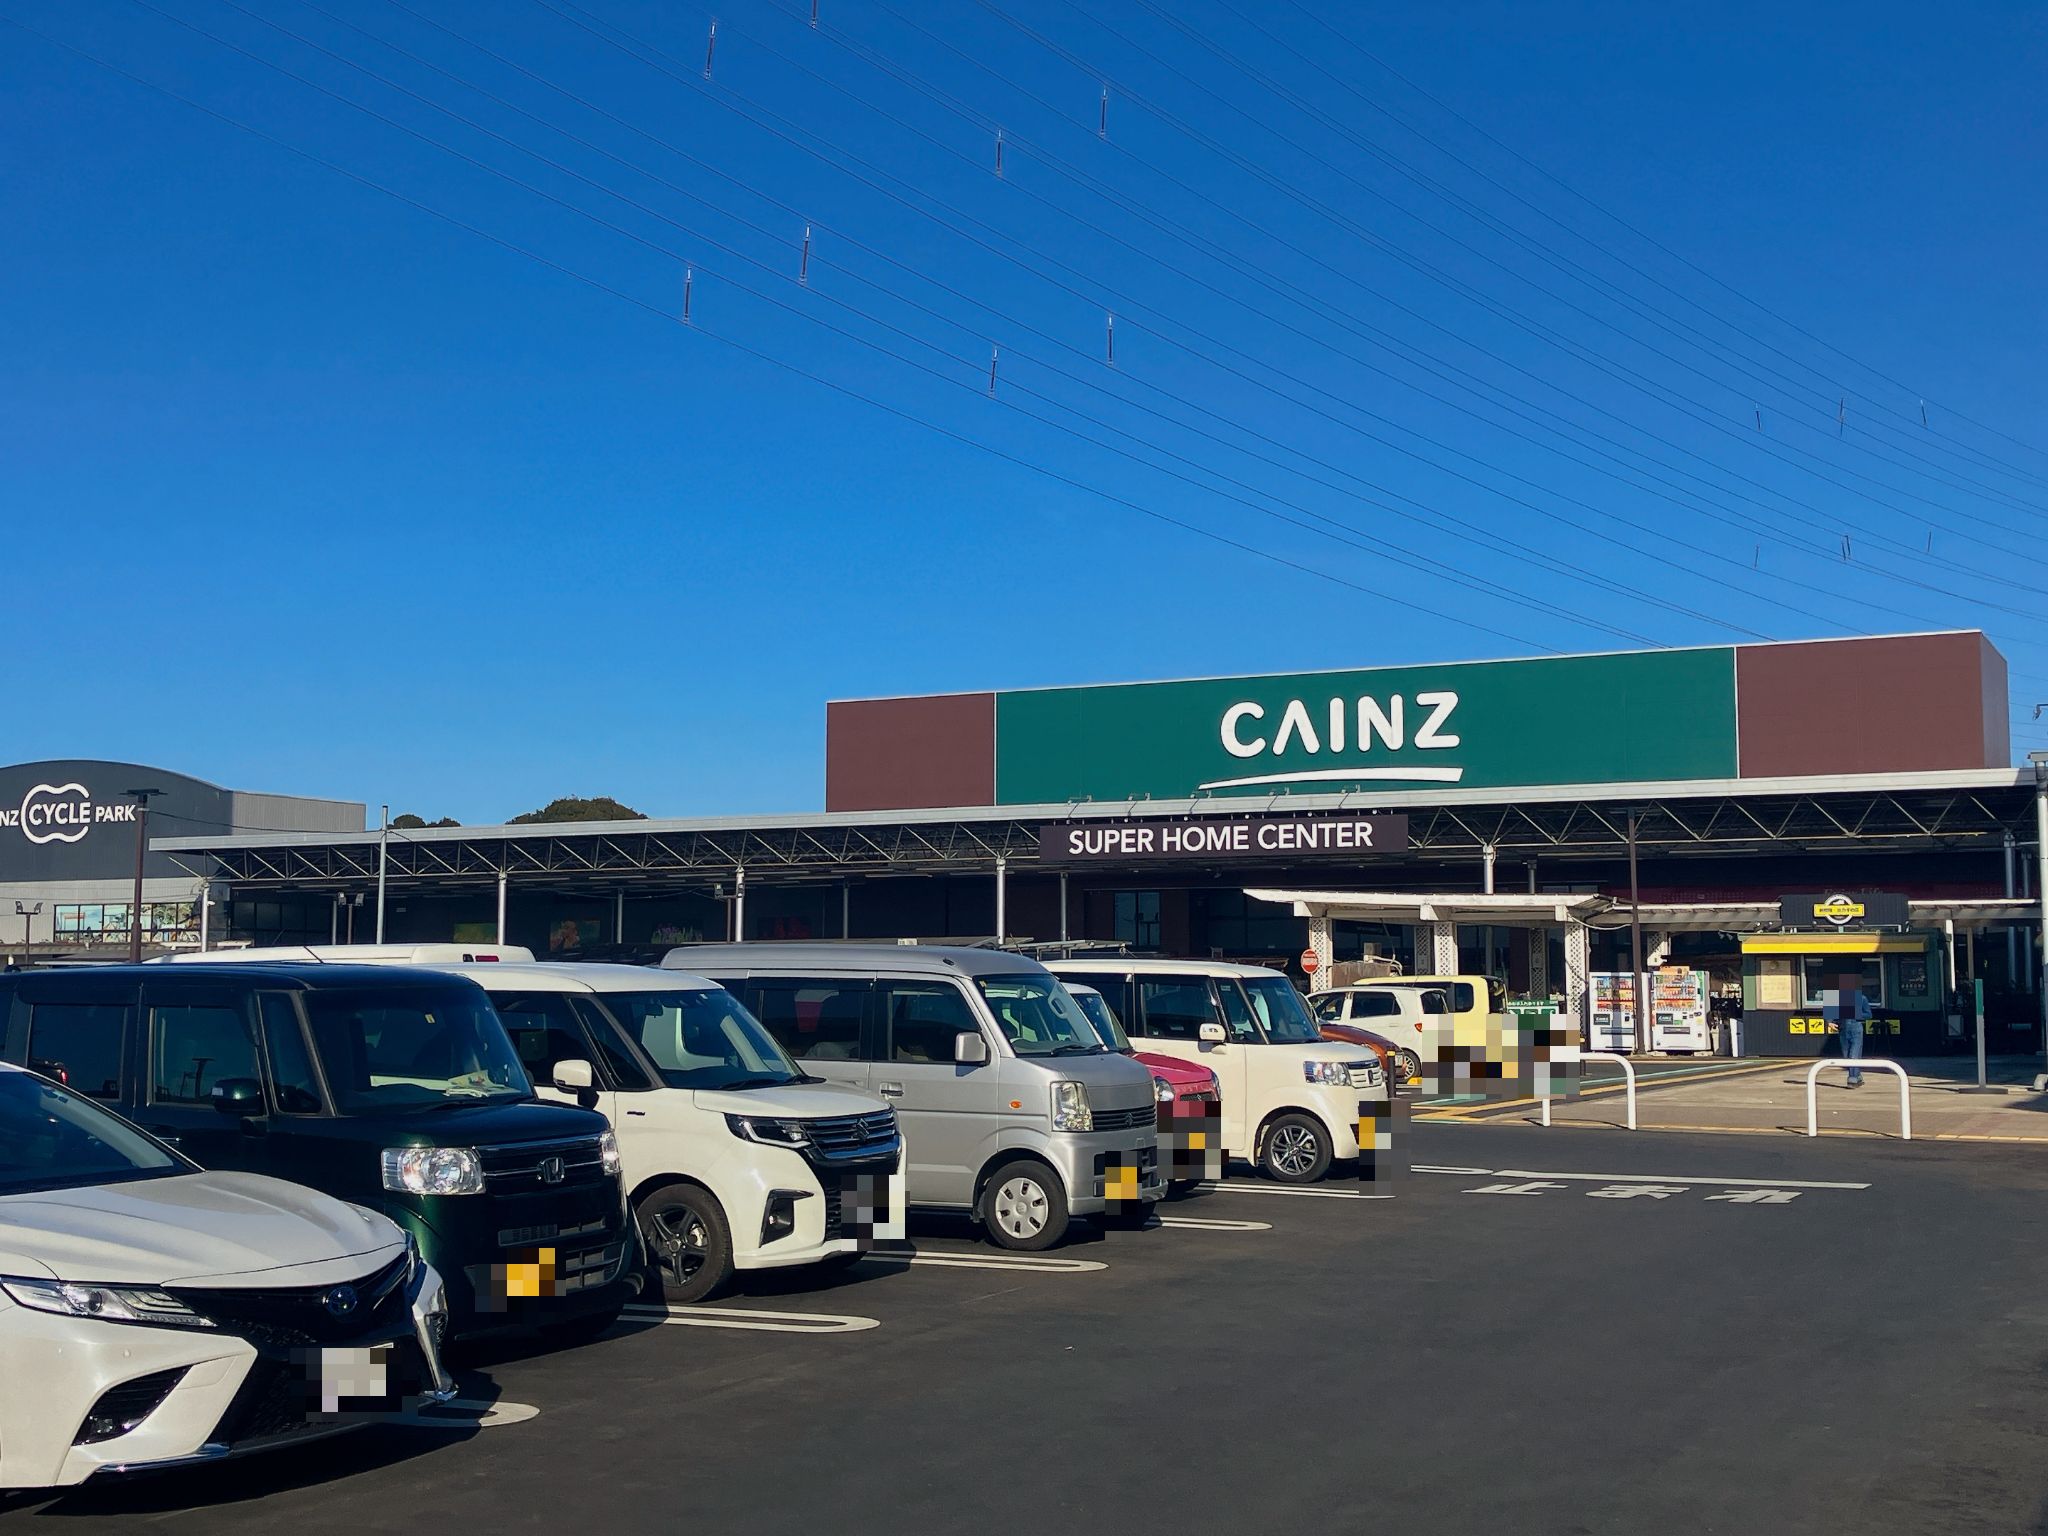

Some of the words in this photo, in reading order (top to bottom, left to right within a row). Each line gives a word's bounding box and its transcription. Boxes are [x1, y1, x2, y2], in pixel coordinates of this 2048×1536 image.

[1220, 691, 1461, 758] CAINZ
[29, 802, 91, 826] CYCLE
[95, 804, 136, 823] PARK
[1068, 829, 1153, 855] SUPER
[1162, 824, 1250, 852] HOME
[1257, 822, 1373, 850] CENTER
[1461, 1181, 1802, 1203] 止まれ
